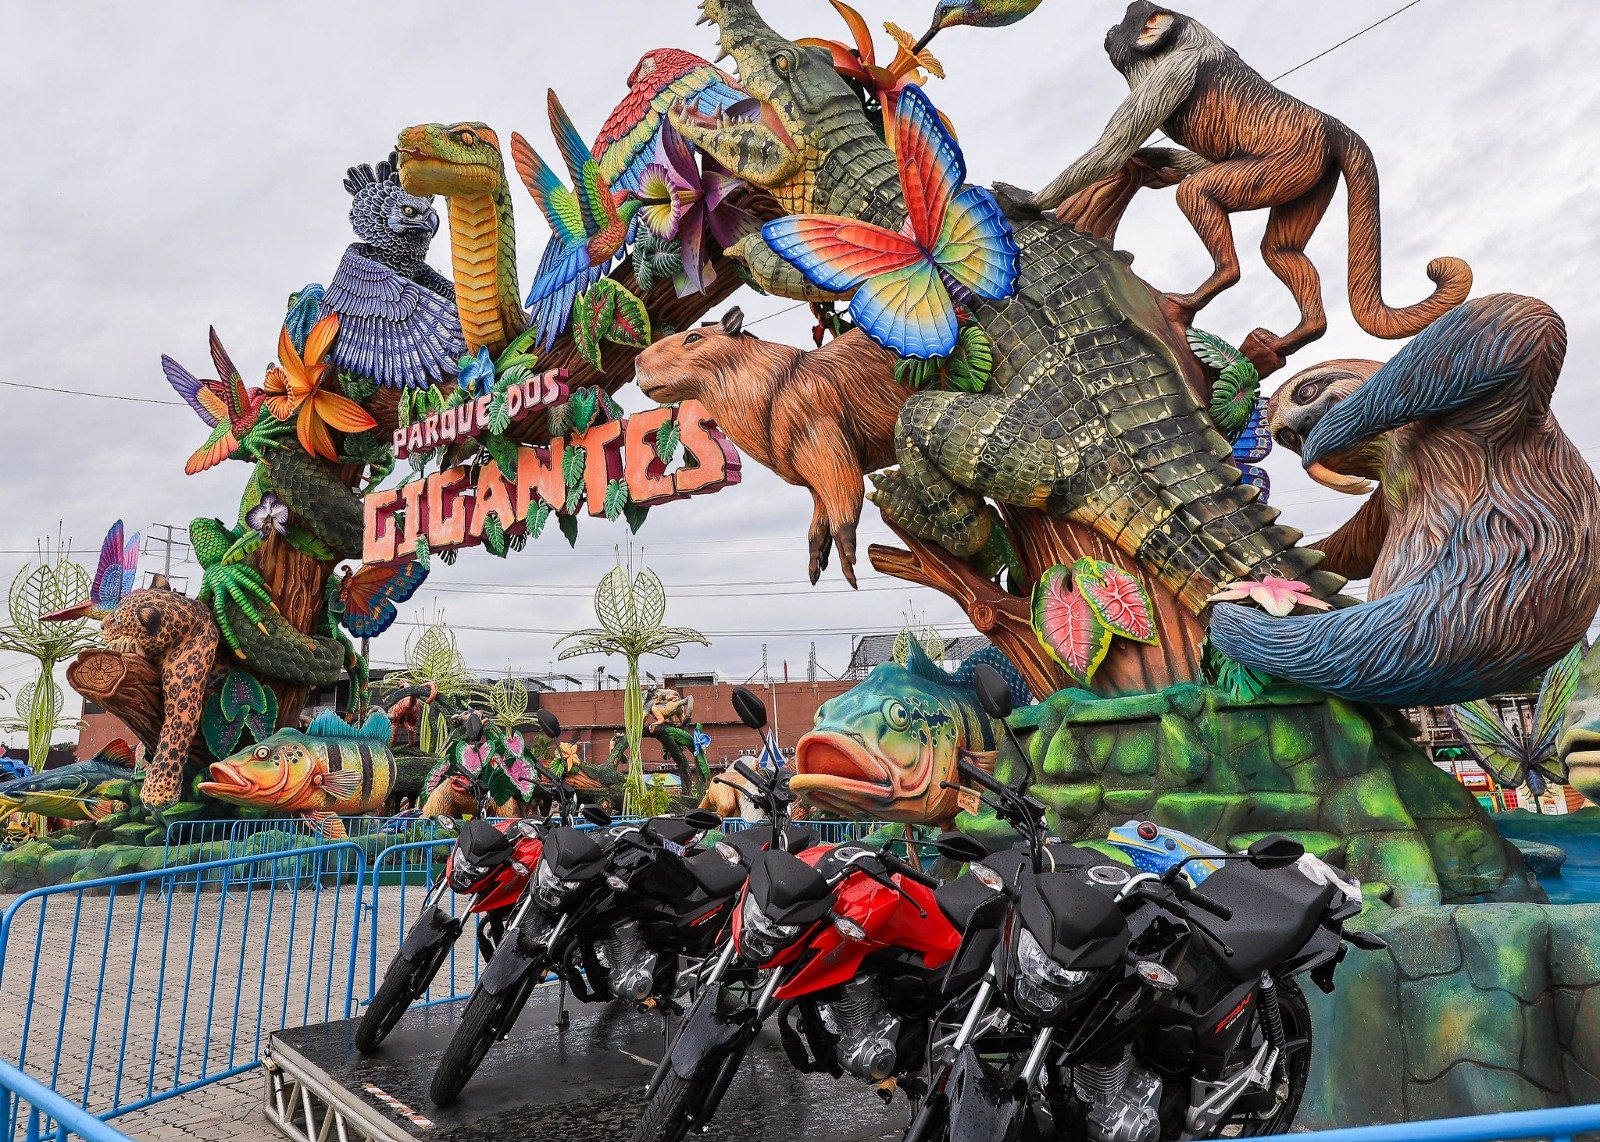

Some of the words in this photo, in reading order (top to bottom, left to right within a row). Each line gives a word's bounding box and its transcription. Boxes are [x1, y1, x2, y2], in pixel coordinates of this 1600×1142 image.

[393, 394, 493, 459] PARQUE
[507, 368, 568, 418] DOS
[362, 399, 741, 567] GIGANTES
